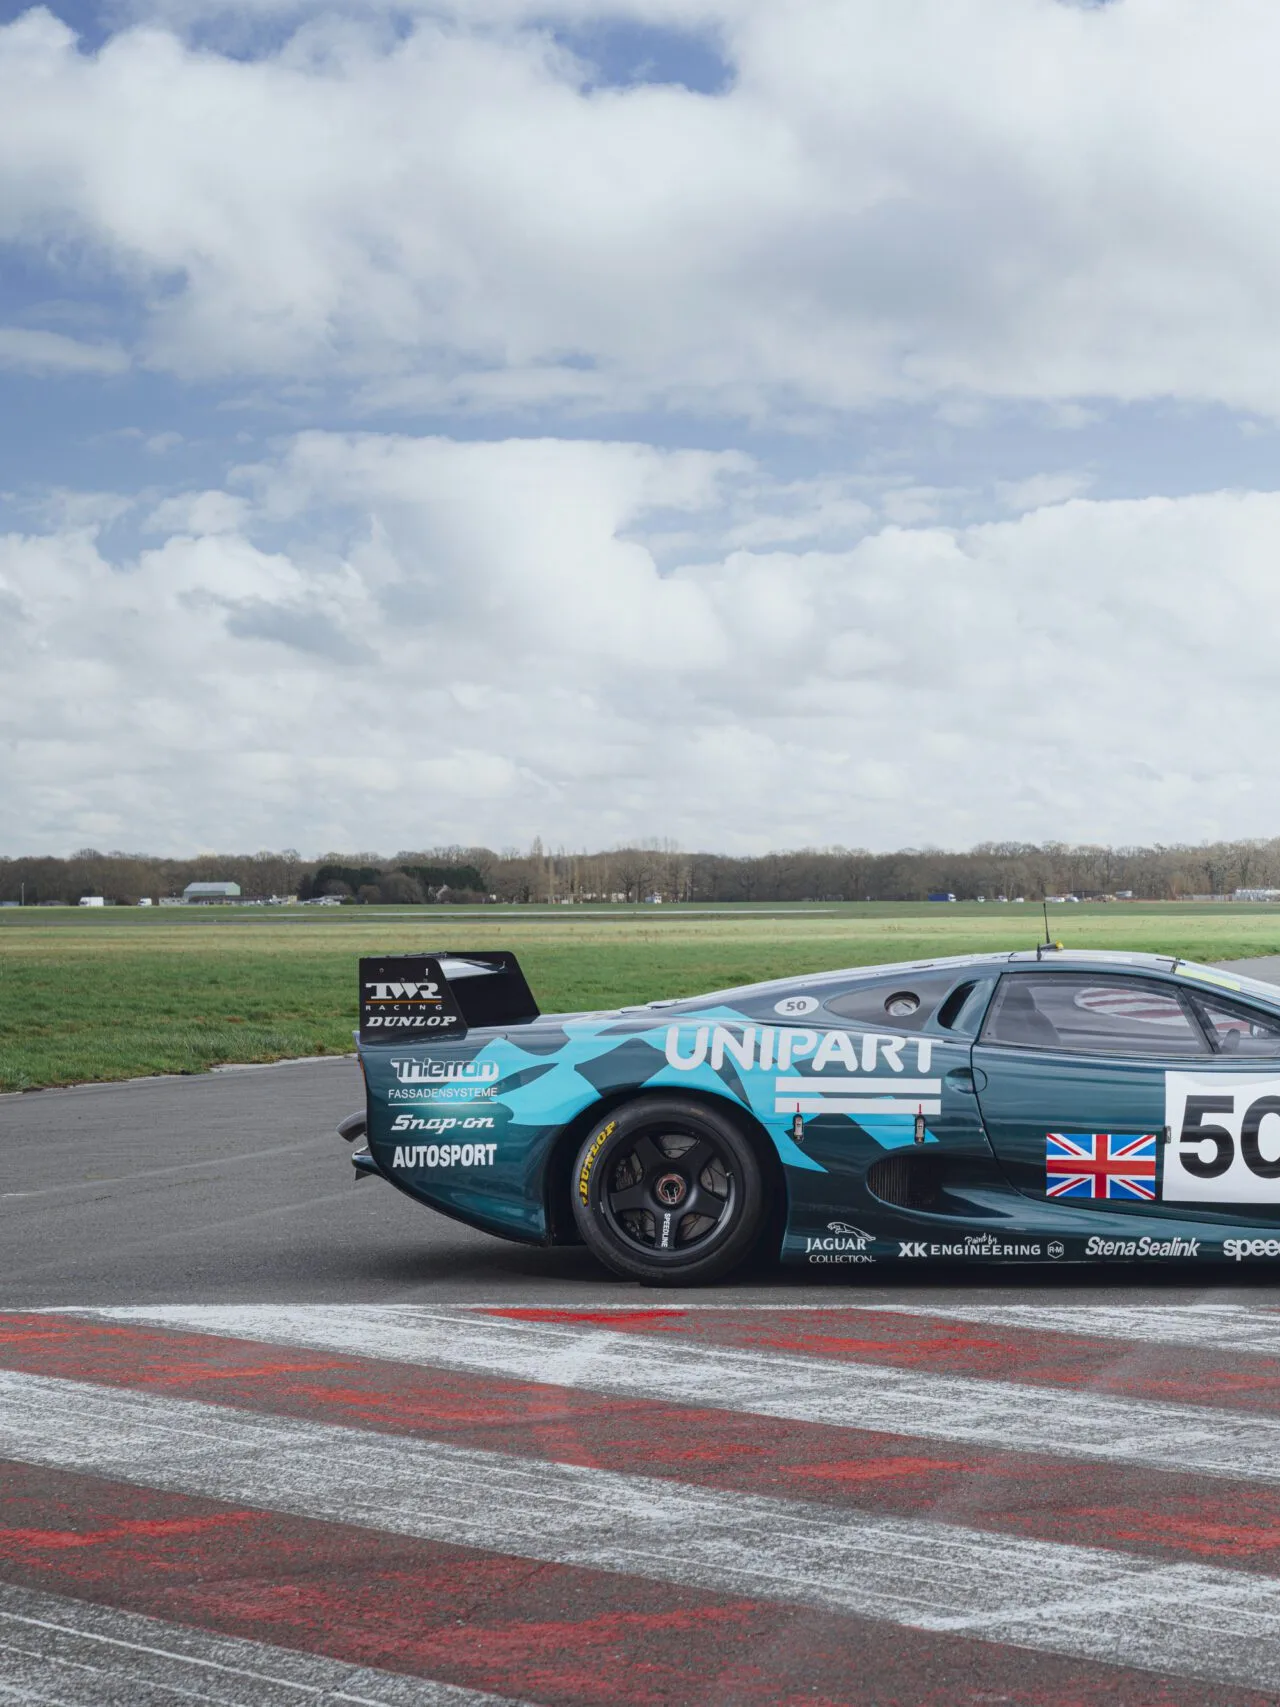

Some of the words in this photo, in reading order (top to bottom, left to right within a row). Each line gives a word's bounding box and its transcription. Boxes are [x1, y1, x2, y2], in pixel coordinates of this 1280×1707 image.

[365, 982, 442, 1000] TWR
[785, 1000, 807, 1012] 50
[366, 1015, 457, 1027] DUNLOP
[665, 1026, 944, 1073] UNIPART
[391, 1058, 499, 1083] Thierron
[388, 1087, 498, 1099] FASSADENSYSTEME
[391, 1114, 495, 1134] Snap-on
[392, 1143, 497, 1168] AUTOSPORT
[579, 1120, 617, 1198] DUNLOP
[661, 1212, 672, 1248] SPEEDLINE
[804, 1237, 867, 1253] JAGUAR
[964, 1232, 987, 1246] Paint
[987, 1234, 998, 1246] by
[898, 1242, 928, 1257] XK
[930, 1244, 1041, 1256] ENGINEERING
[808, 1254, 876, 1264] COLLECTION
